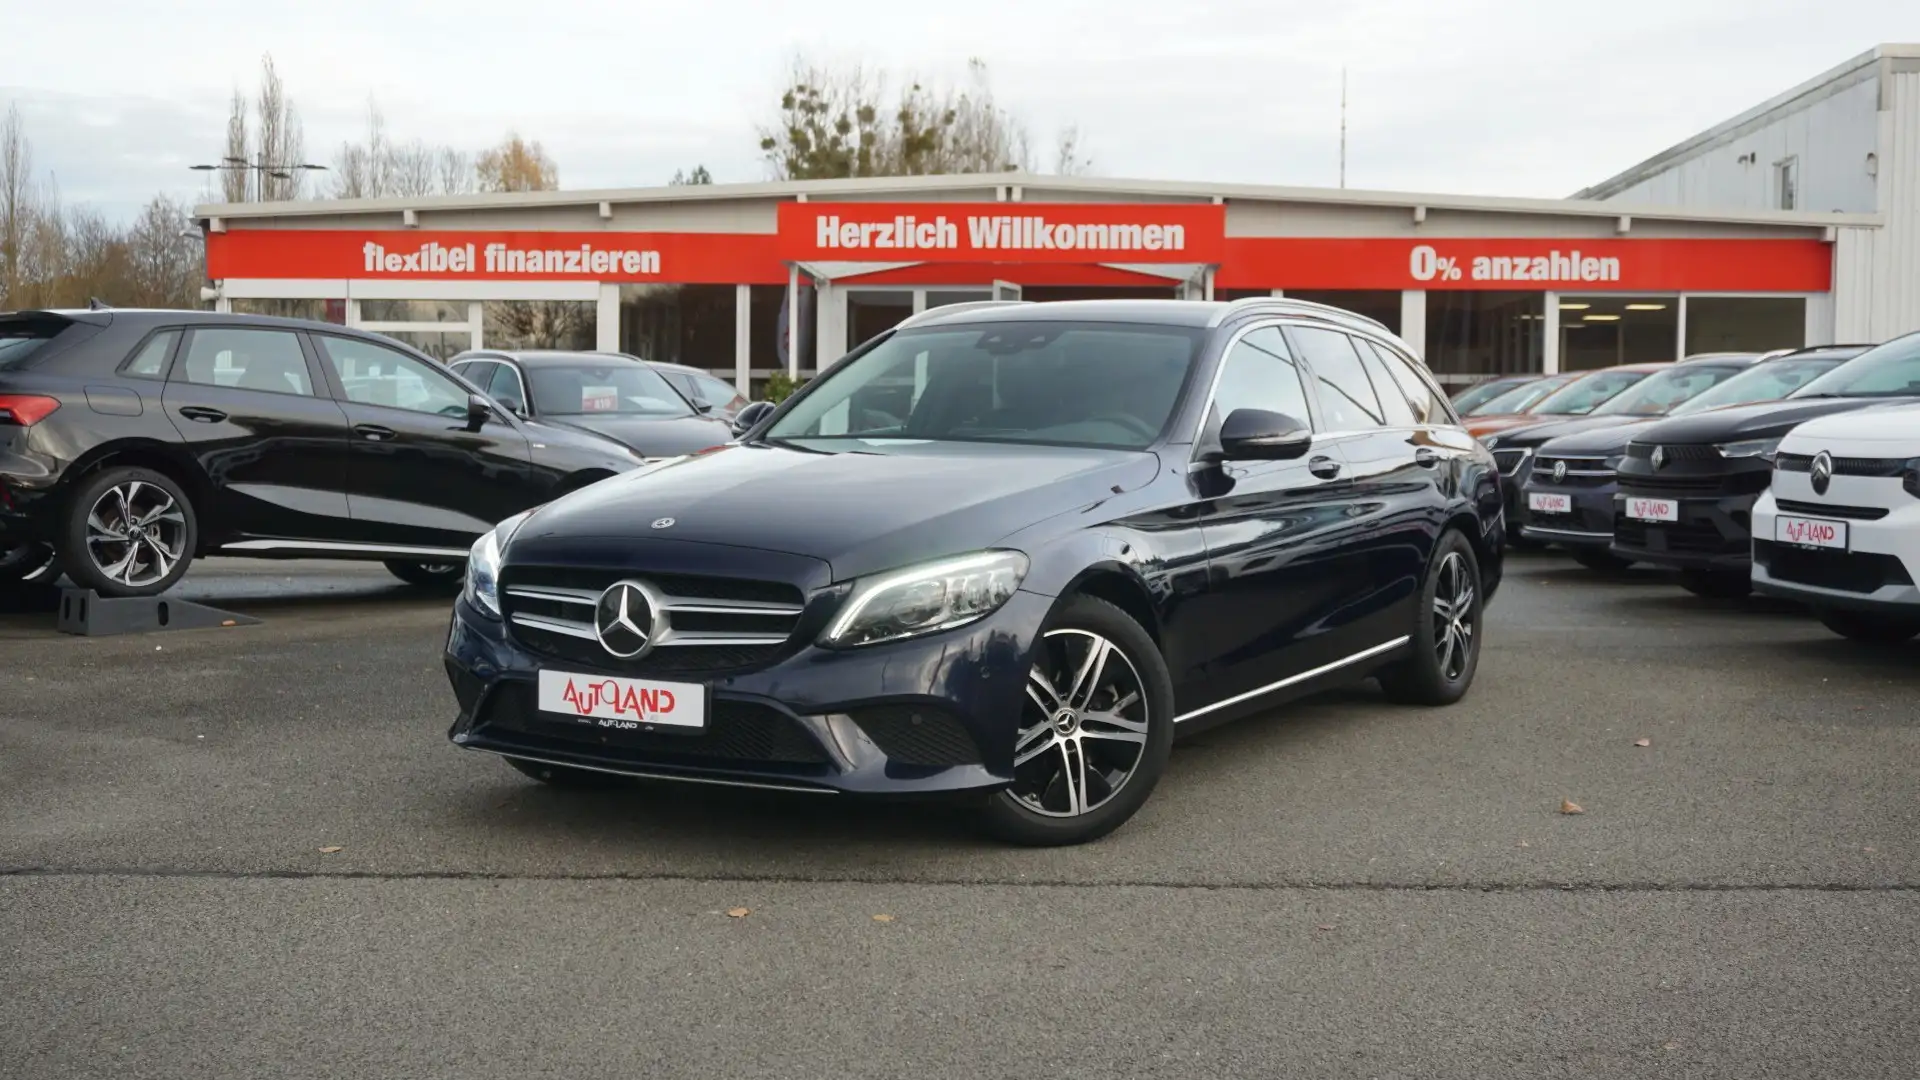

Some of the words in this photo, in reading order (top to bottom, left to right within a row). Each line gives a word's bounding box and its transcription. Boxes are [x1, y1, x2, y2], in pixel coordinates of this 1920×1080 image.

[816, 216, 958, 248] Herzlich
[968, 217, 1185, 250] Willkommen
[363, 241, 475, 272] flexibel
[484, 243, 660, 273] finanzieren
[1410, 245, 1462, 281] 0%
[1471, 250, 1620, 281] anzahlen
[1786, 520, 1835, 544] AUTOLAND
[563, 678, 675, 719] AUTOLAND
